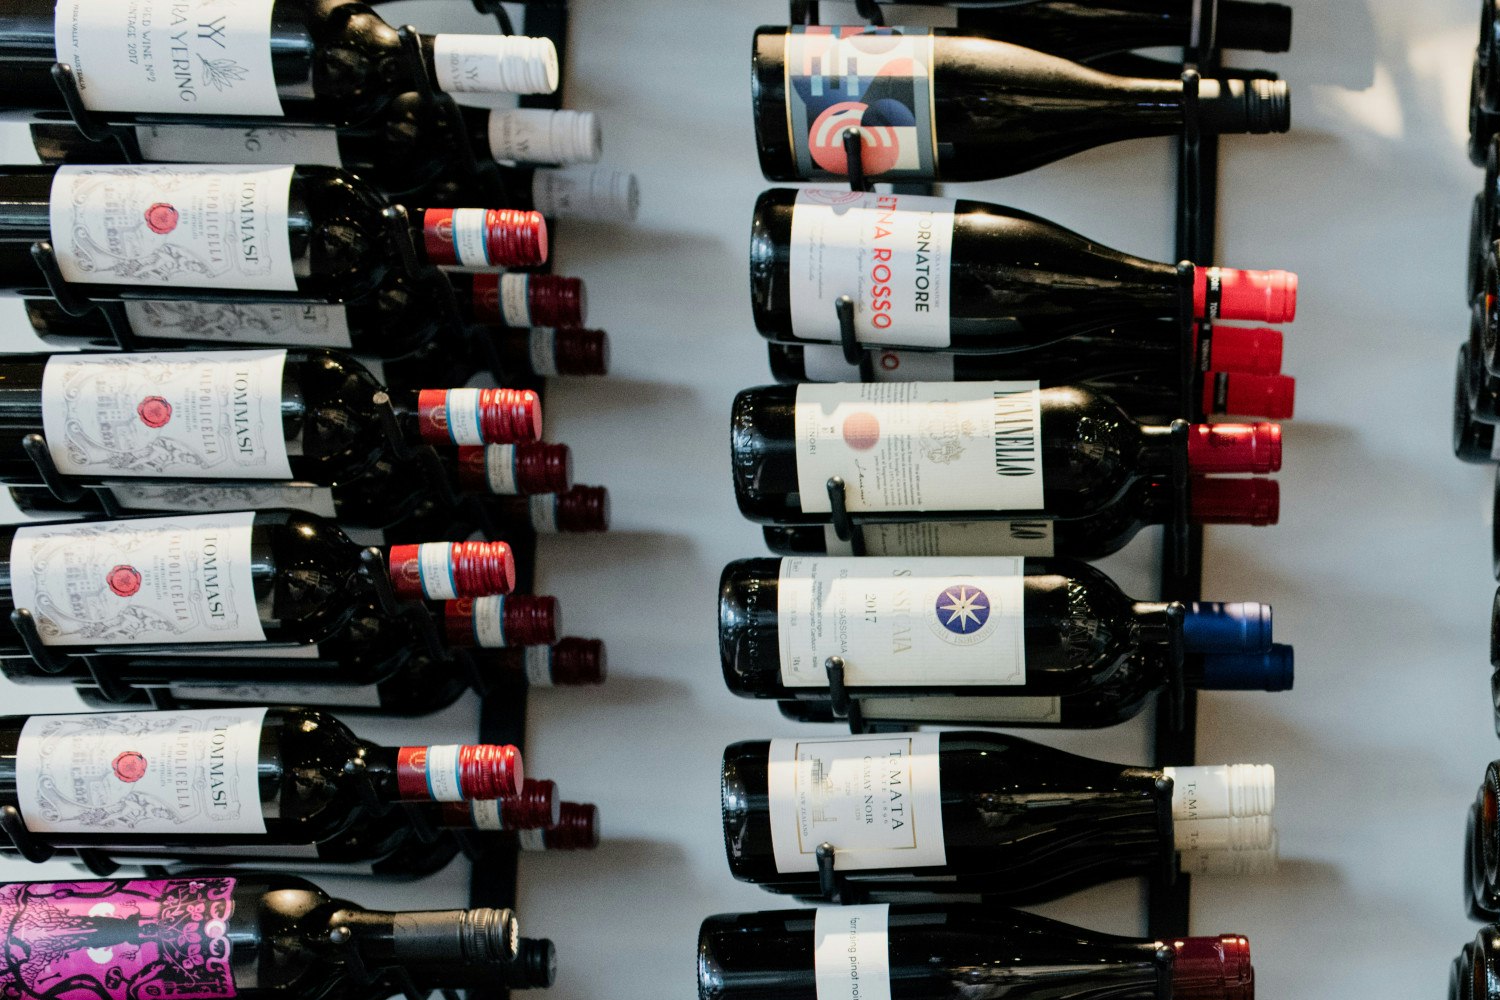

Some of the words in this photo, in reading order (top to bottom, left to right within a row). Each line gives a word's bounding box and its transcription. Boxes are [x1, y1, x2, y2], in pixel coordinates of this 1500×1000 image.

[72, 24, 80, 48] VALLEY
[127, 43, 138, 65] 2017
[142, 31, 153, 62] WINE
[74, 54, 86, 91] AUSTRALIA
[170, 31, 197, 102] YERING
[240, 182, 259, 264] TOMMASI
[874, 196, 897, 239] ETNA
[915, 212, 933, 312] ORNATORE
[871, 248, 893, 330] ROSSO
[233, 372, 254, 456] TOMMASI
[204, 536, 225, 620] TOMMASI
[865, 593, 877, 623] 2017
[839, 608, 848, 654] SASSICAIA
[210, 724, 228, 808] TOMMASI
[864, 795, 873, 824] NOIR
[890, 770, 904, 830] MATA
[801, 807, 809, 837] ZEALAND
[850, 917, 859, 929] farr
[849, 956, 860, 981] pinot
